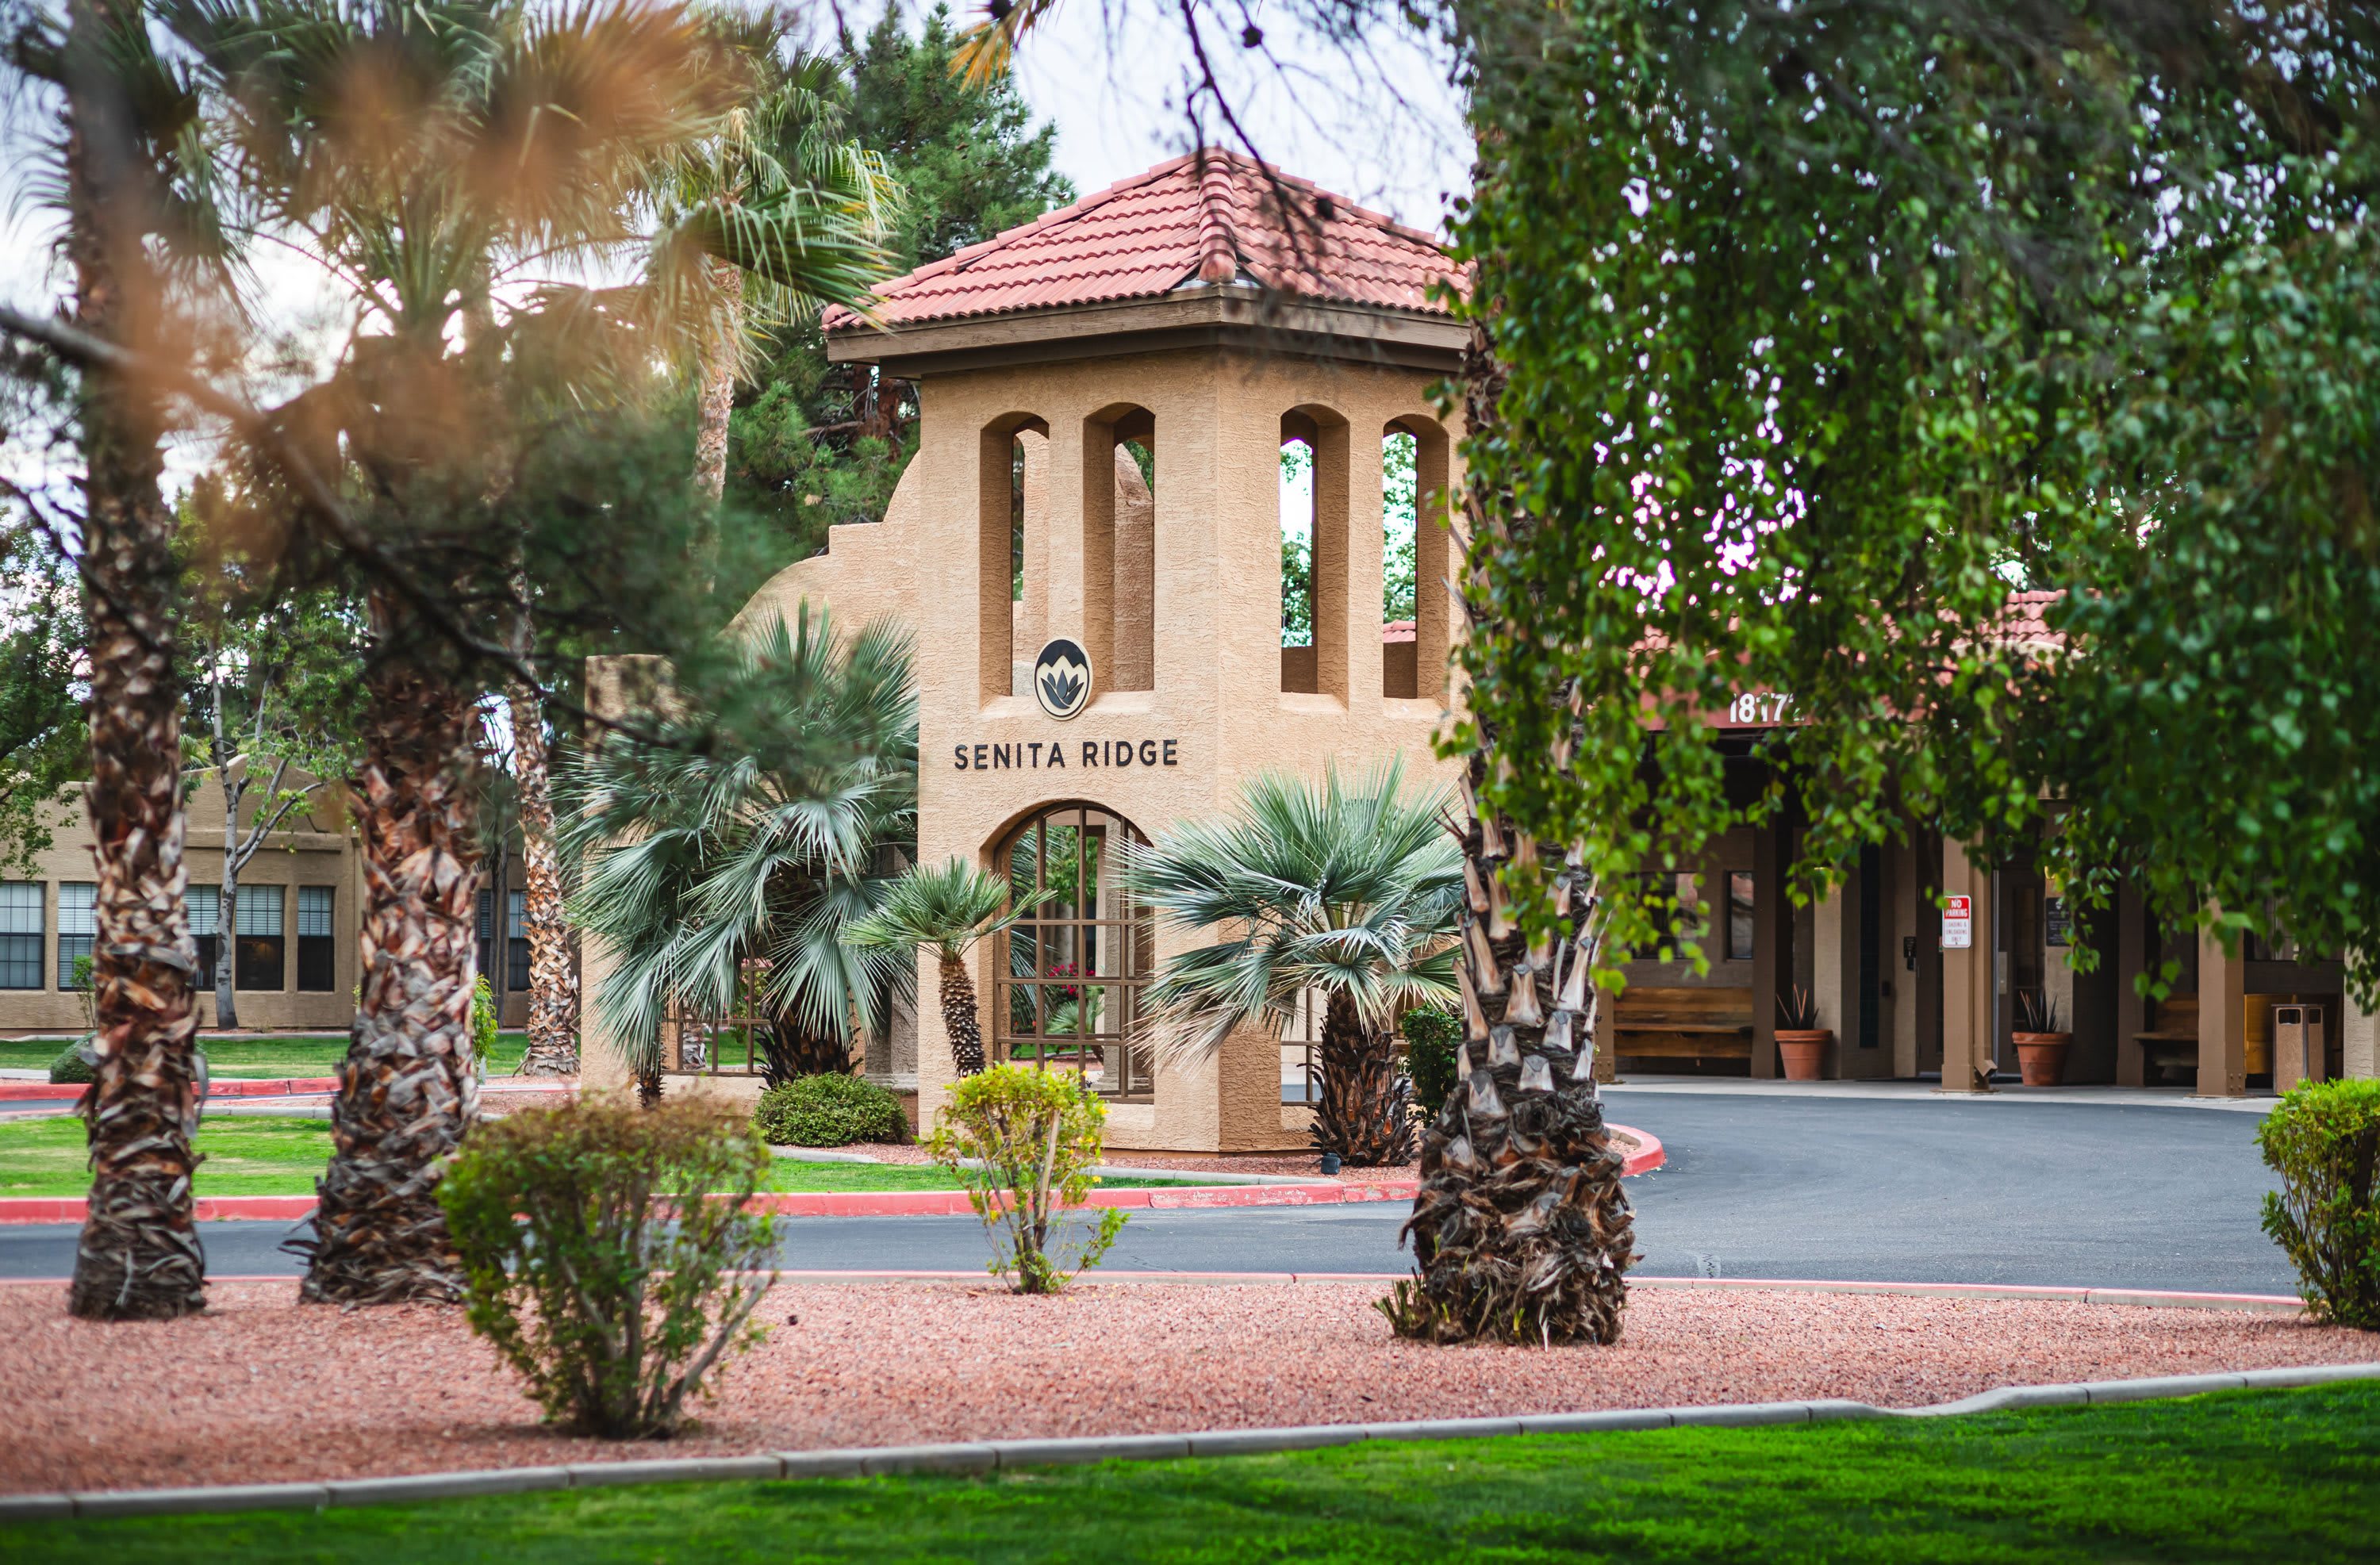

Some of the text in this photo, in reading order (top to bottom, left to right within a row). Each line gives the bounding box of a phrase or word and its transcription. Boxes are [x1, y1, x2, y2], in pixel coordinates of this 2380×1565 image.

[1730, 692, 1805, 723] 1817
[954, 738, 1178, 769] SENITA RIDGE
[1945, 908, 1967, 917] PARKING
[1951, 899, 1963, 908] NO
